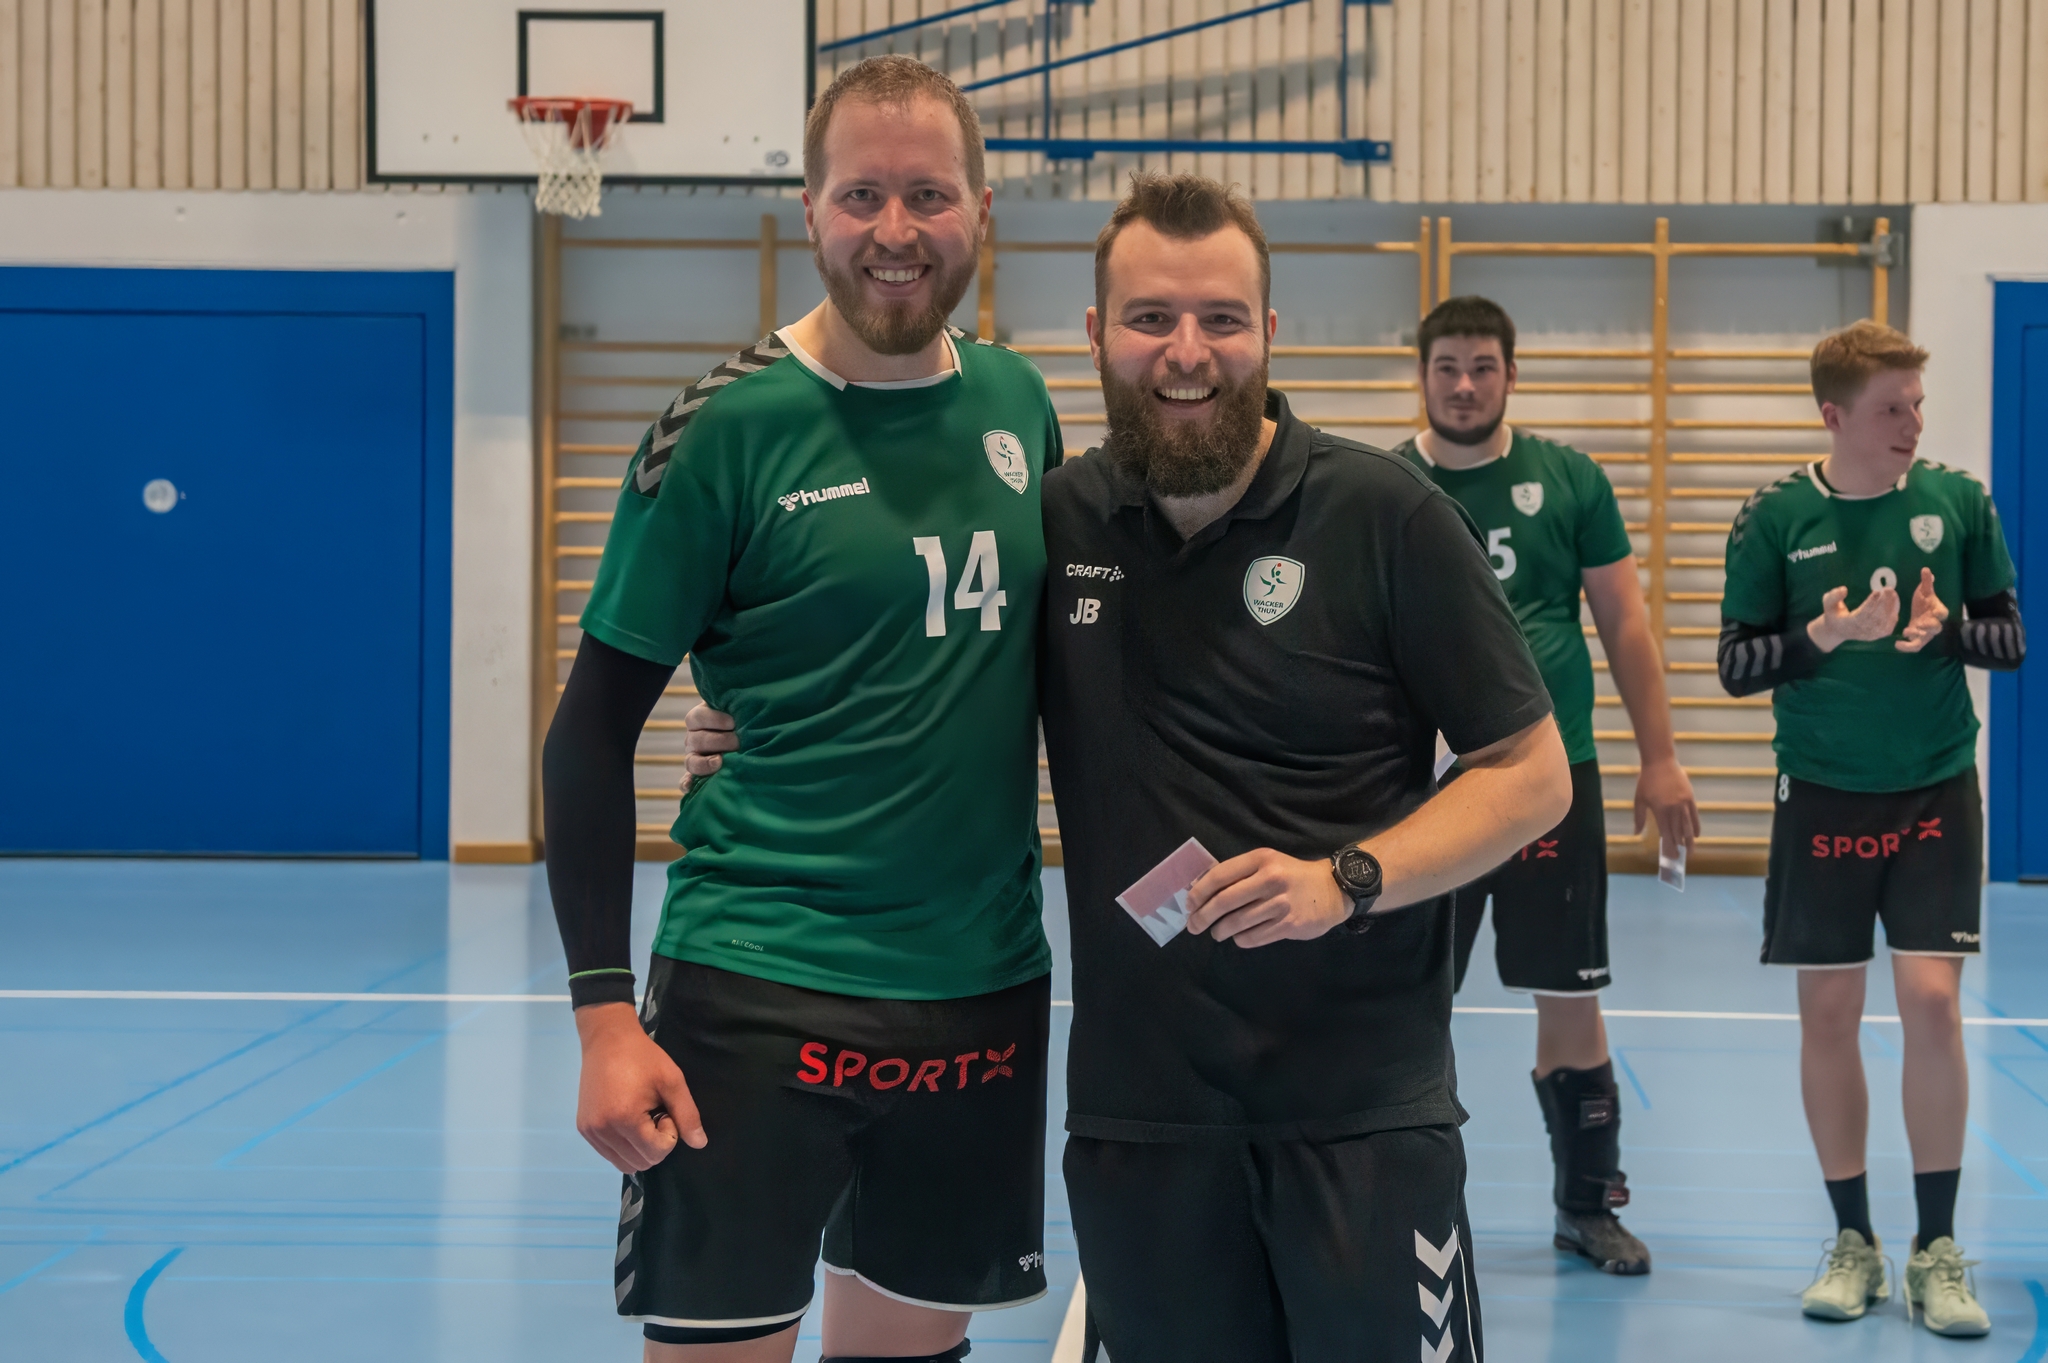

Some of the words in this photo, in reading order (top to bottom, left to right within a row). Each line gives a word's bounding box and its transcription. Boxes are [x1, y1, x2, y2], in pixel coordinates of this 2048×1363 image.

[800, 476, 871, 506] hummel
[912, 530, 1007, 638] 14
[1065, 562, 1112, 580] CRAFT
[1069, 597, 1101, 625] JB
[1253, 599, 1284, 608] WACKER
[1778, 773, 1790, 803] 8
